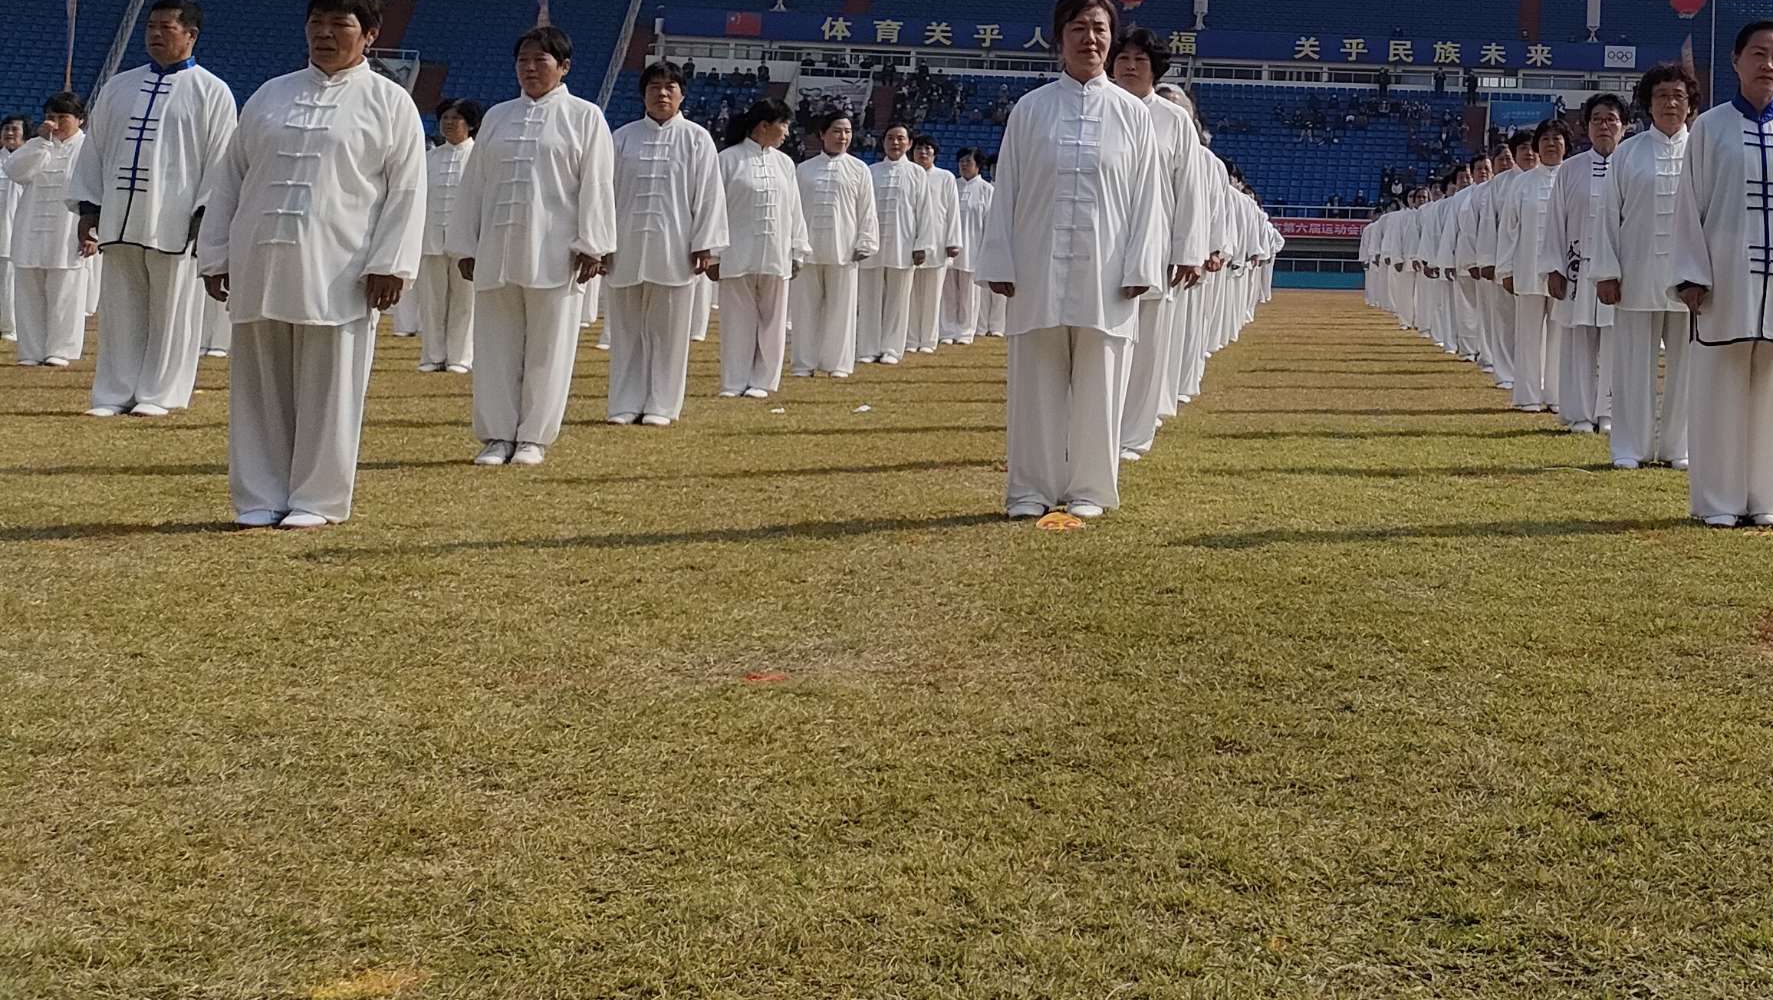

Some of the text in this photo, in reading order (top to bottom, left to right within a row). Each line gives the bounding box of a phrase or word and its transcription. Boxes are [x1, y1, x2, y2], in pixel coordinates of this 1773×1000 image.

[821, 16, 1553, 67] 体育关乎人福 关乎民族未来
[1275, 222, 1364, 236] 第六届运动会
